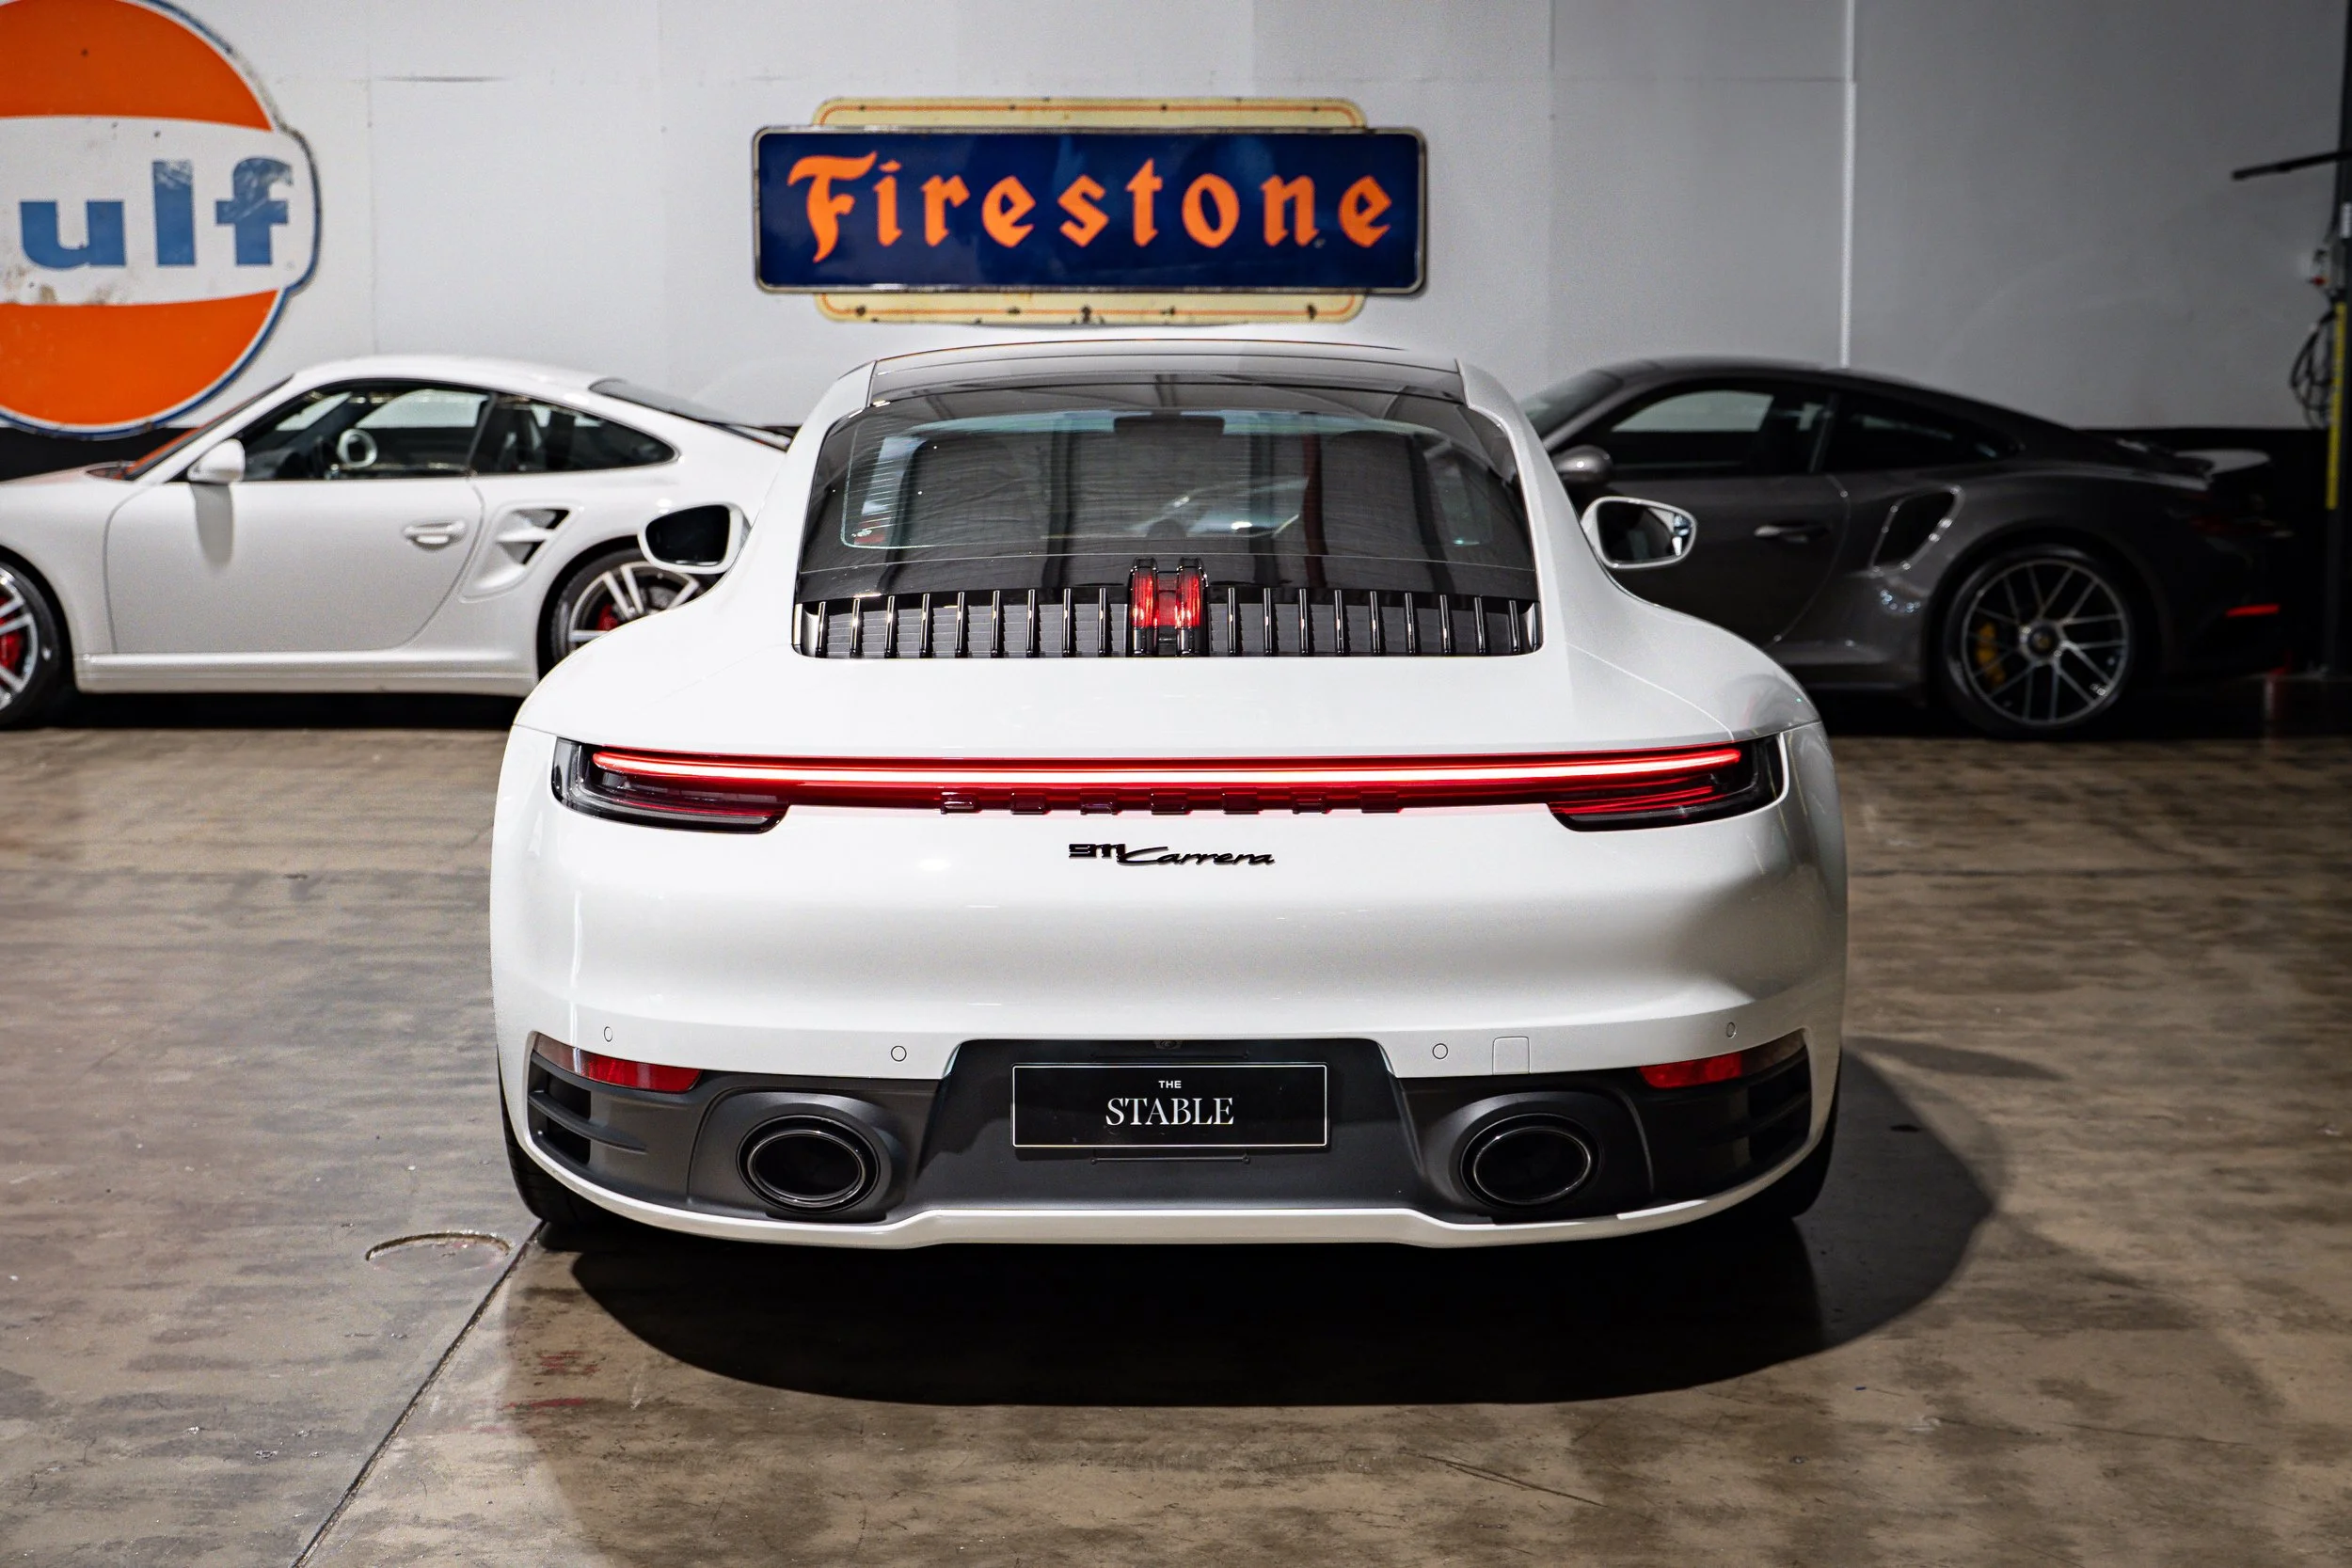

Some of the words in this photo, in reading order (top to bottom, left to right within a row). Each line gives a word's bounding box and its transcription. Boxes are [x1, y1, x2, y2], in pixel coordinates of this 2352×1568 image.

[20, 158, 294, 270] ulf
[787, 151, 1392, 262] Firestone
[1118, 846, 1275, 865] Carrera
[1158, 1080, 1182, 1089] THE
[1105, 1097, 1234, 1126] STABLE
